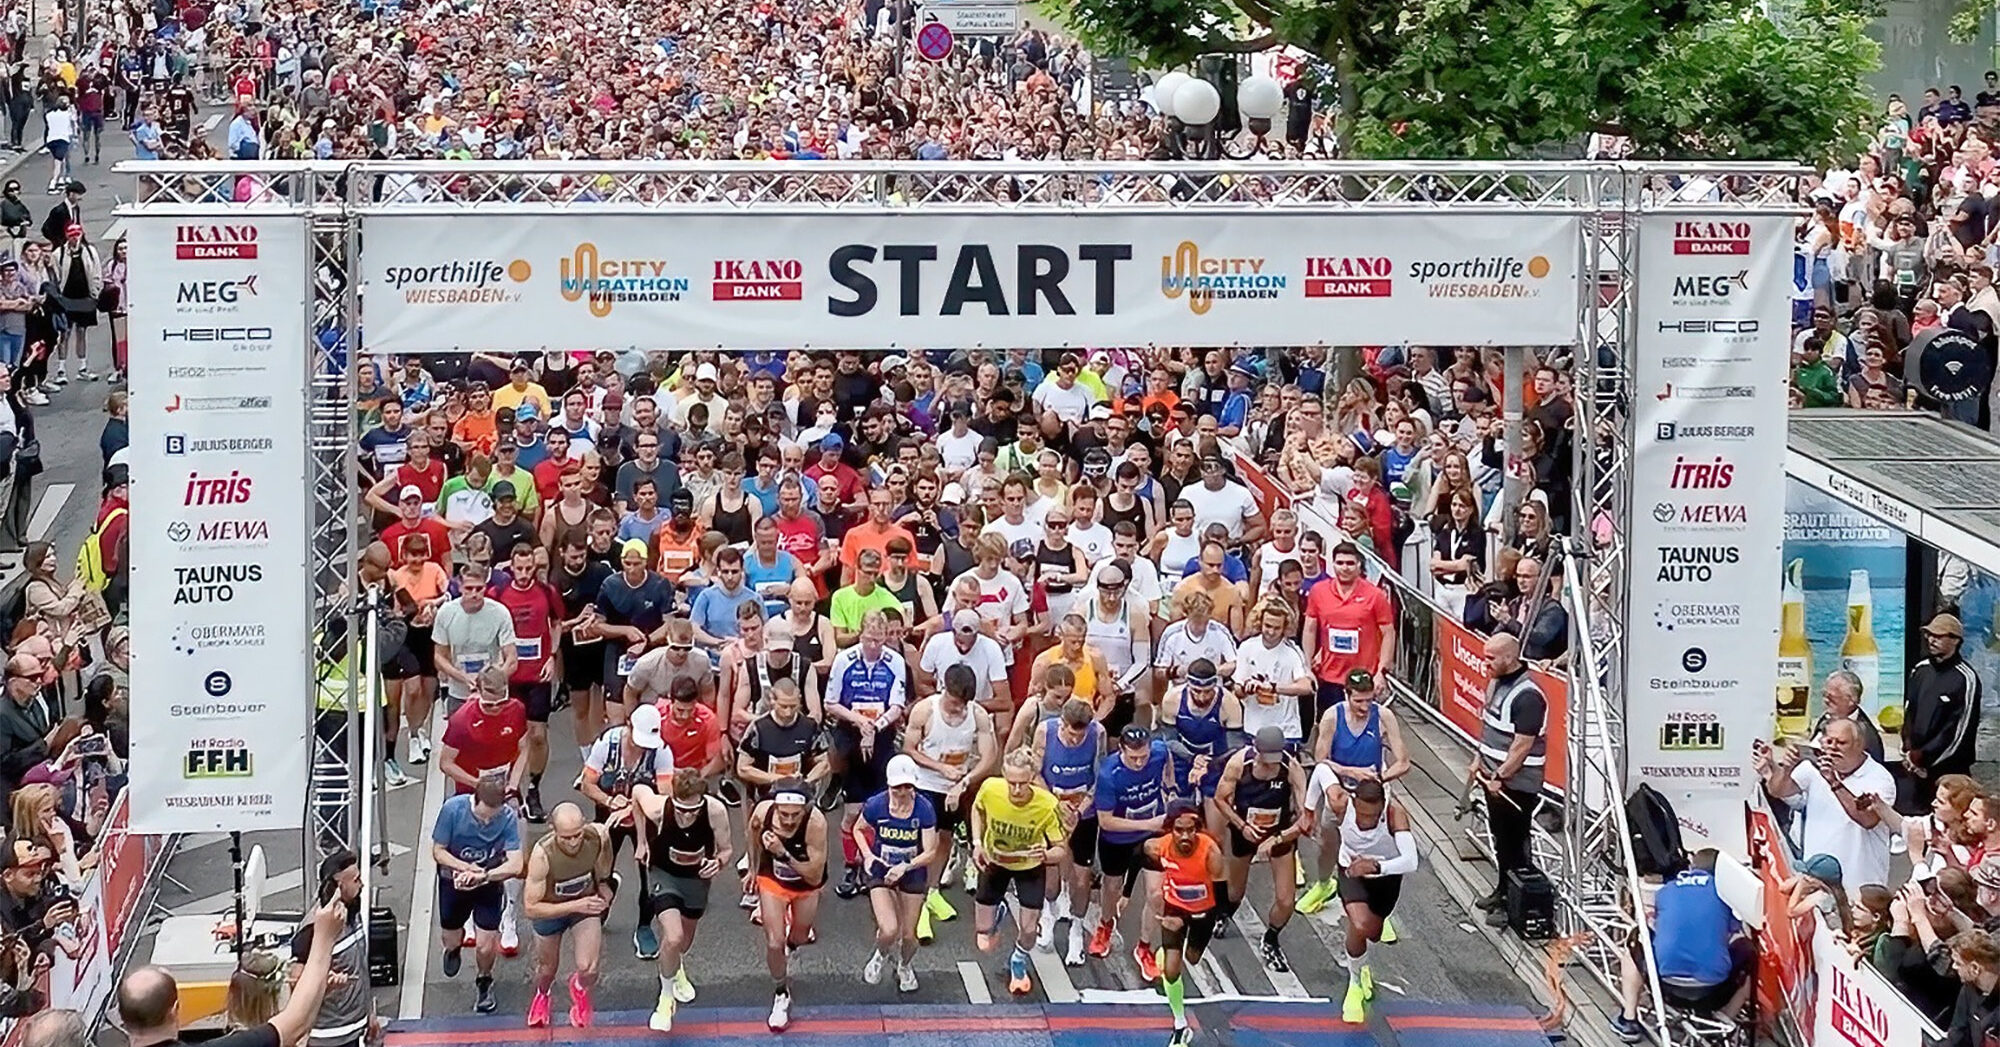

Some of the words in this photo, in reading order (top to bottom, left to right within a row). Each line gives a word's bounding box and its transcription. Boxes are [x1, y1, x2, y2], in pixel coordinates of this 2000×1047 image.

[176, 225, 258, 242] IKANO
[1675, 221, 1751, 239] IKANO
[194, 247, 239, 257] BANK
[1690, 243, 1734, 253] BANK
[385, 259, 504, 289] sporthilfe
[600, 260, 667, 277] CITY
[712, 259, 801, 280] IKANO
[1200, 258, 1265, 275] CITY
[1305, 257, 1392, 278] IKANO
[1409, 255, 1524, 284] sporthilfe
[565, 278, 689, 291] MARATHON
[828, 244, 1133, 317] START
[1166, 276, 1286, 289] MARATHON
[1324, 281, 1372, 294] BANK
[1673, 276, 1730, 297] MEG
[176, 282, 238, 303] MEG
[405, 288, 505, 303] WIESBADEN
[589, 292, 680, 302] WIESBADEN
[733, 284, 782, 298] BANK
[1189, 289, 1279, 299] WIESBADEN
[1428, 283, 1523, 298] WIESBADEN
[163, 327, 272, 342] HEICO
[1659, 319, 1759, 334] HEICO
[1714, 425, 1755, 438] BERGER
[229, 438, 273, 451] BERGER
[1680, 504, 1748, 523] MEWA
[197, 521, 270, 541] MEWA
[1658, 547, 1740, 564] TAUNUS
[174, 565, 263, 585] TAUNUS
[1657, 565, 1712, 582] AUTO
[173, 585, 234, 605] AUTO
[1671, 604, 1741, 617] OBERMAYR
[1452, 634, 1489, 678] Unsere
[1650, 678, 1739, 690] Steinbauer
[170, 703, 267, 717] Steinbauer
[1664, 722, 1720, 745] FFH
[188, 749, 249, 774] FFH
[1831, 964, 1889, 1042] IKANO
